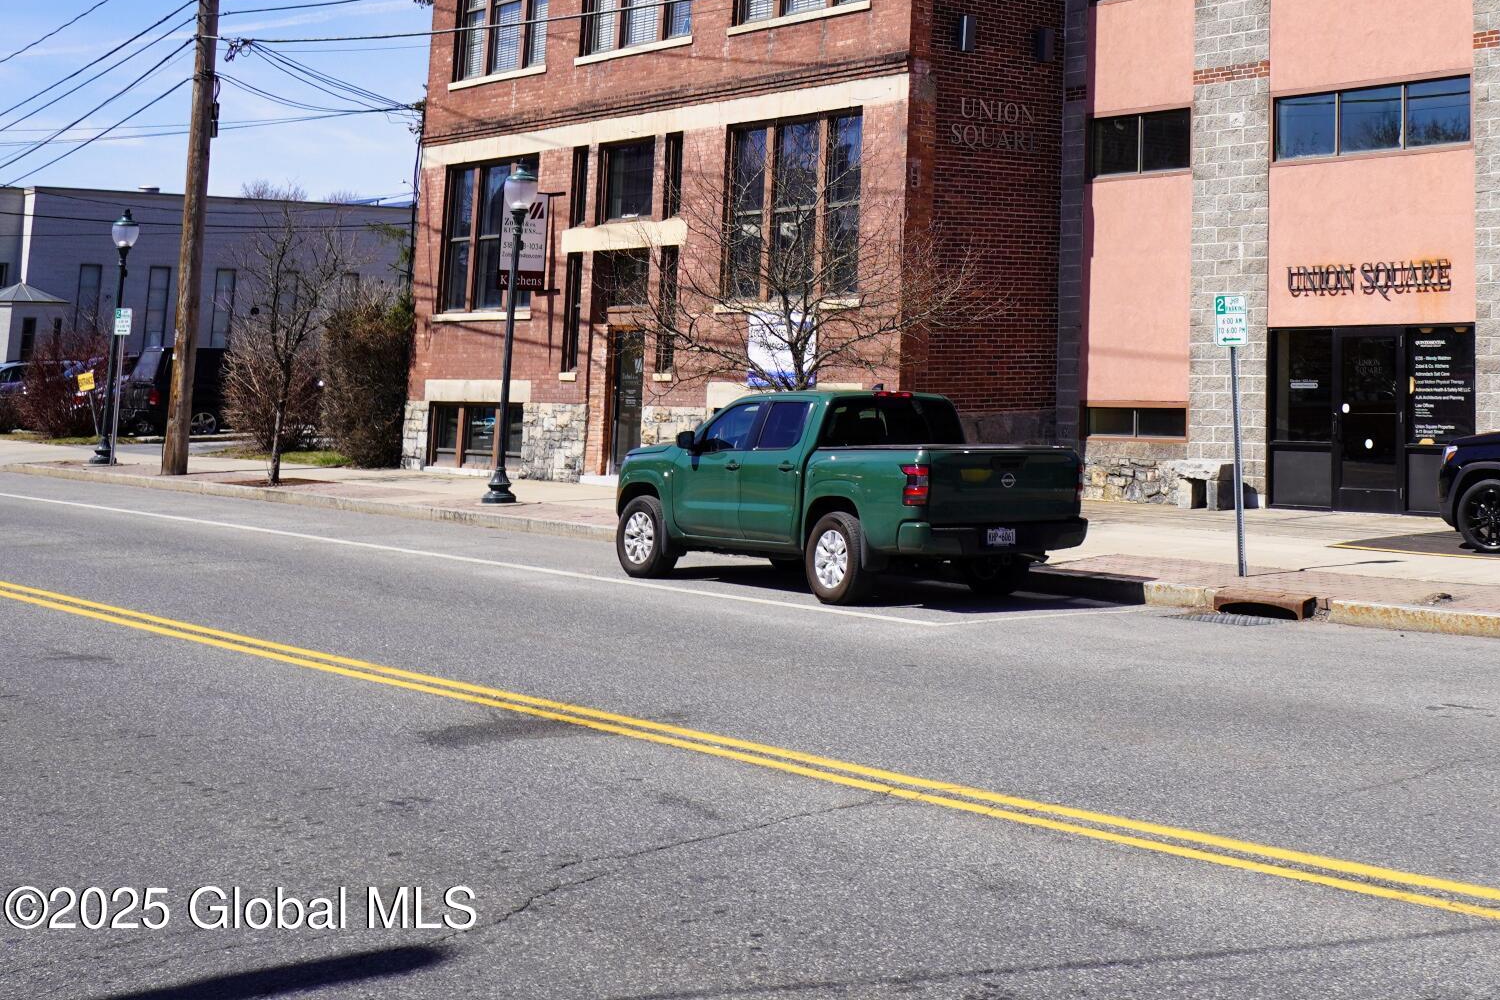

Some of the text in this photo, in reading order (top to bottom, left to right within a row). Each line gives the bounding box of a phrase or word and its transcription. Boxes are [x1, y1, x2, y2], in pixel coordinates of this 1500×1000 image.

[960, 97, 1036, 124] UNION
[951, 123, 1036, 152] SQUARE
[500, 274, 542, 285] Kchens
[1287, 264, 1355, 296] UNION
[1360, 258, 1451, 301] SQUARE
[1217, 298, 1225, 311] 2
